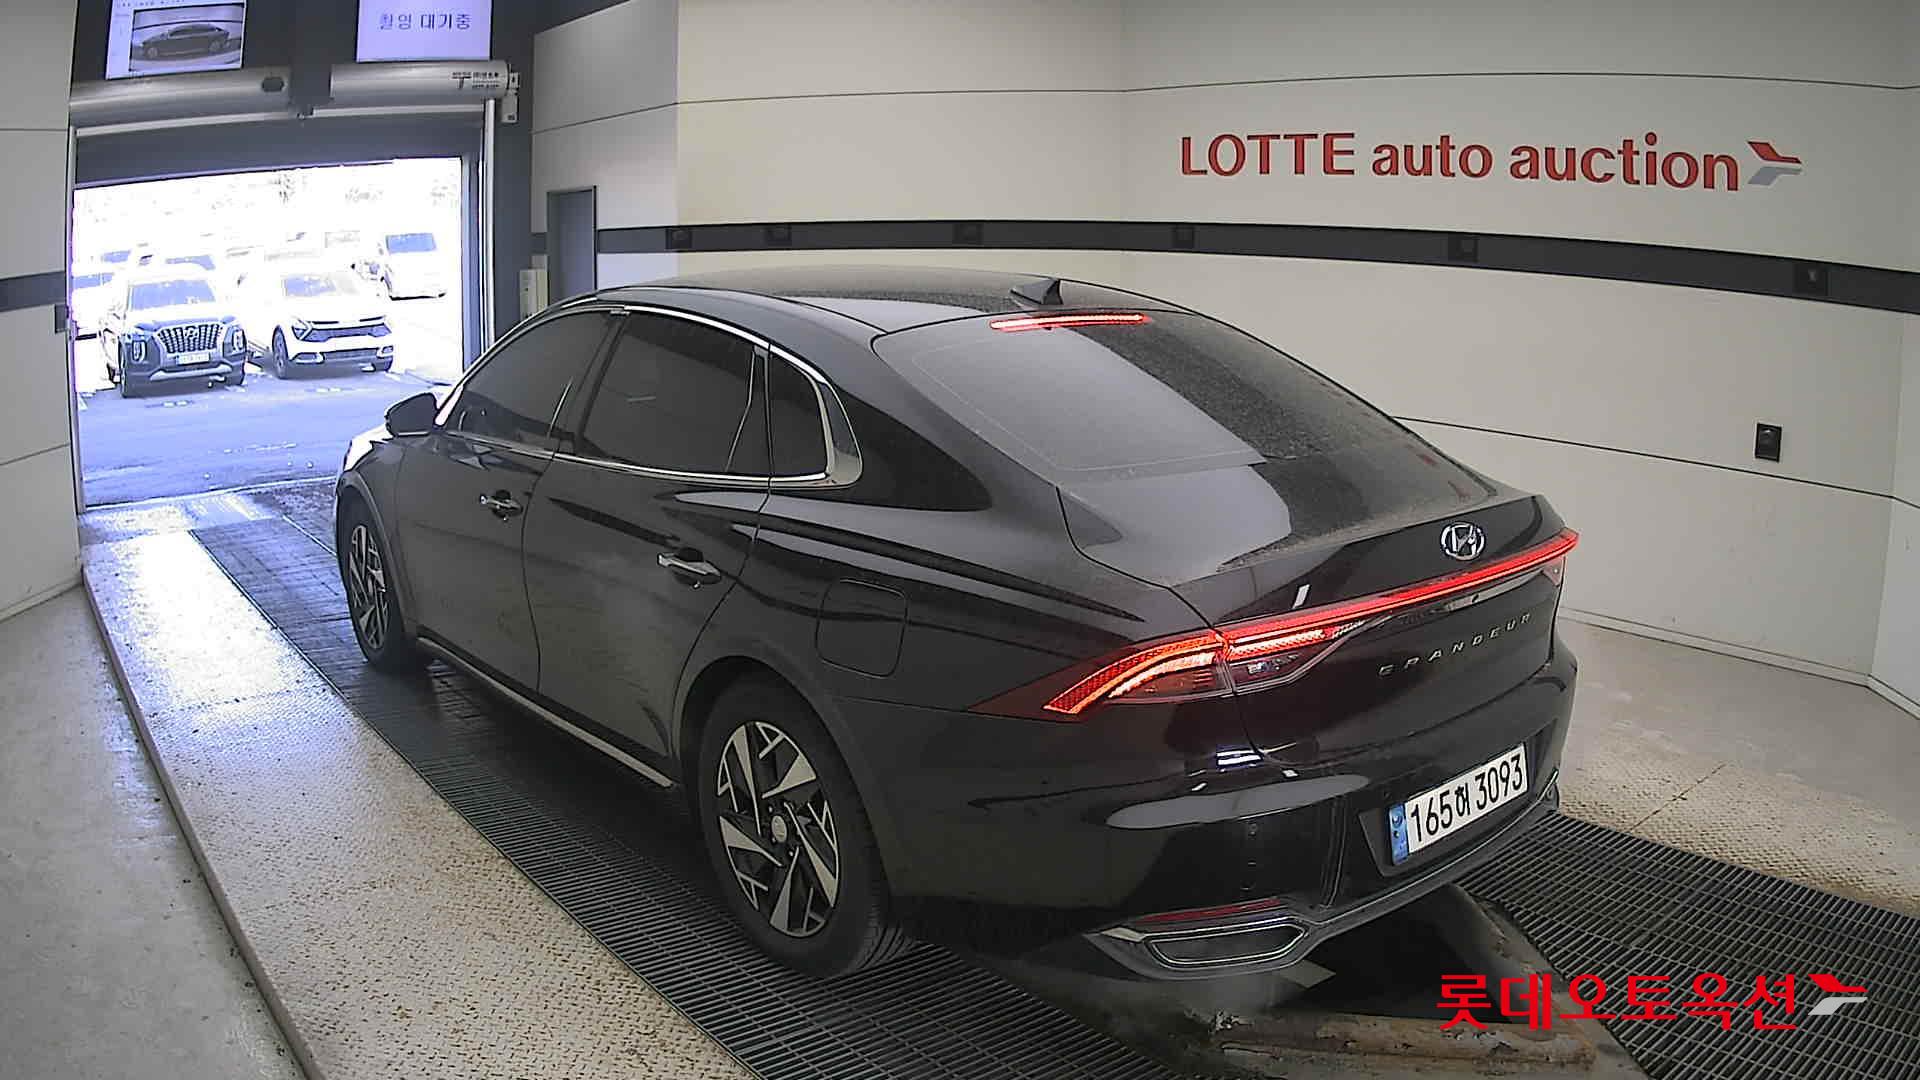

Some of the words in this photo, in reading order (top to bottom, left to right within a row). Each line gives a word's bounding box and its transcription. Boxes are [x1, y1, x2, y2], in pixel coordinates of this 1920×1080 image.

[421, 13, 472, 31] 대기중
[1182, 132, 1356, 177] LOTTE
[1372, 134, 1493, 178] auto
[1510, 132, 1738, 191] auction
[1379, 613, 1531, 677] GRANDEUR
[1410, 785, 1471, 843] 165허
[1474, 753, 1524, 808] 3093
